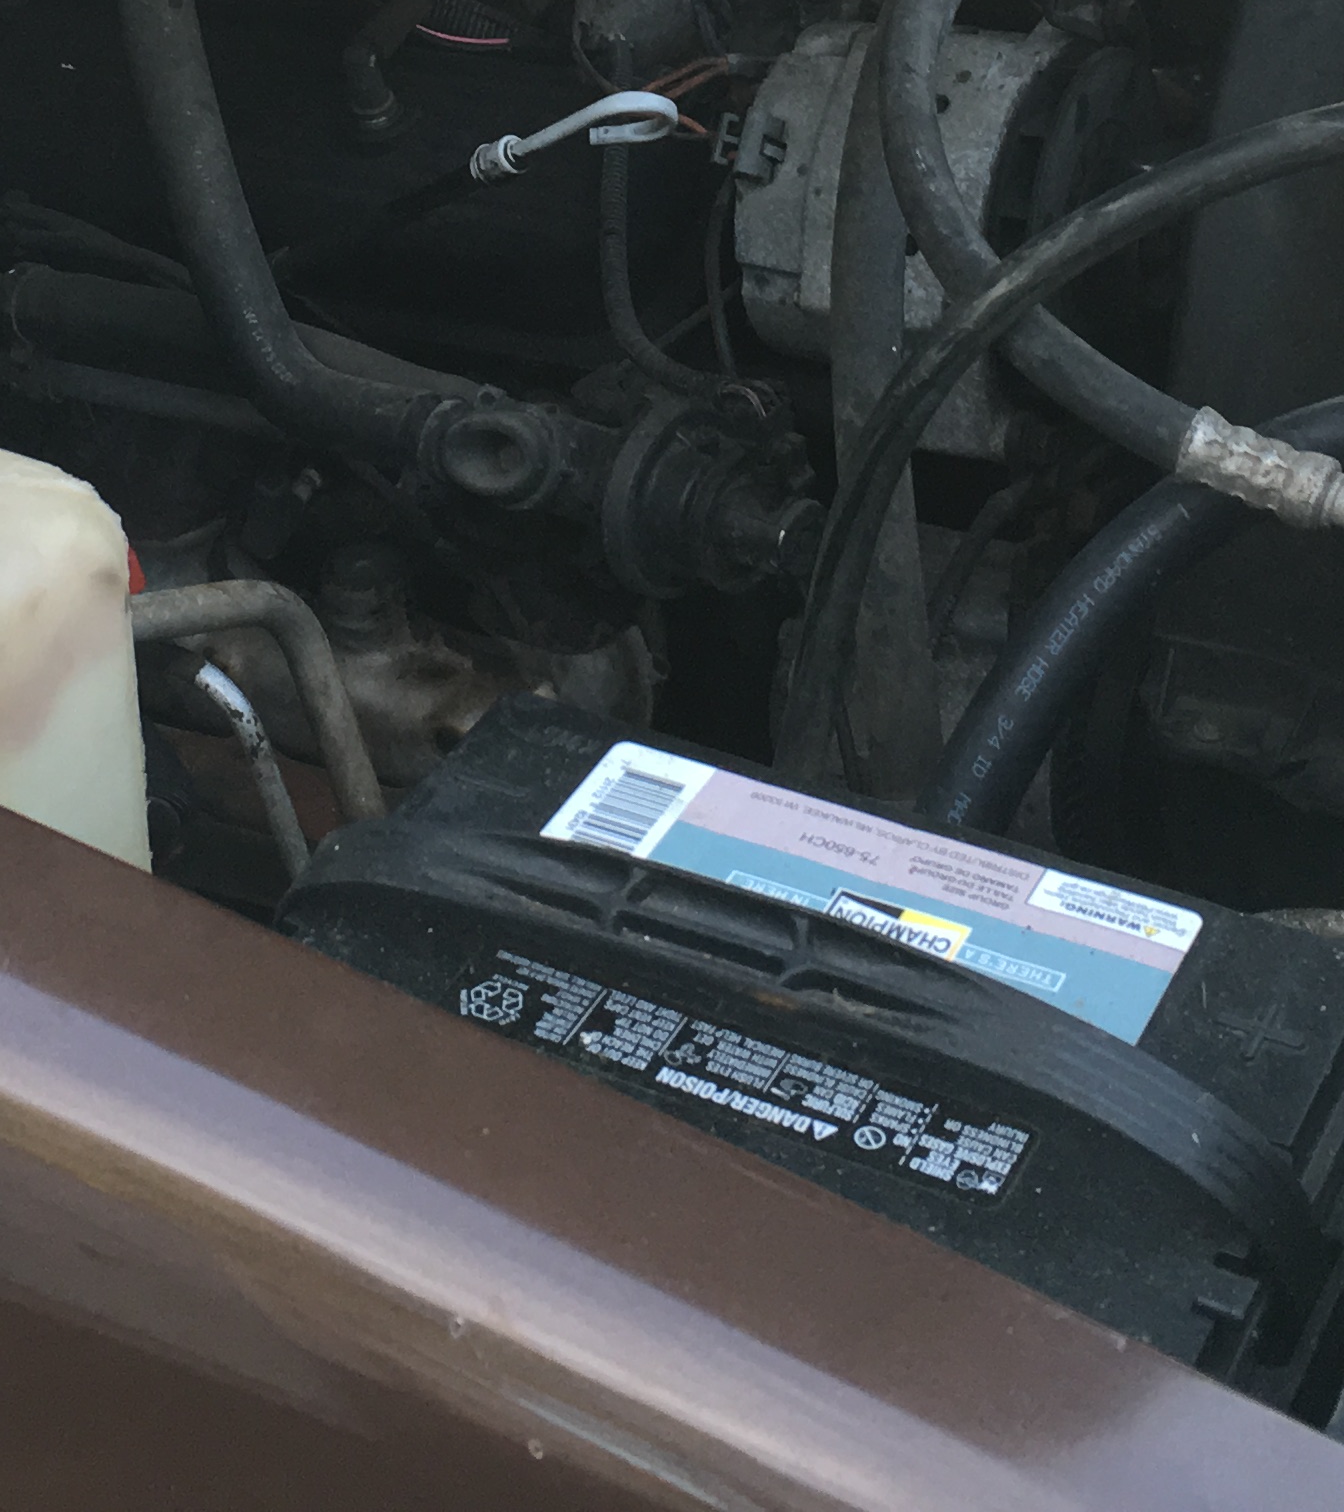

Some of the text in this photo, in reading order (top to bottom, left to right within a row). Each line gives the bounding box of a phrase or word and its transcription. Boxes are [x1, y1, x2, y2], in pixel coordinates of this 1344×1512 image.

[1093, 524, 1163, 594] STANDARD
[1045, 592, 1096, 656] HEATER
[1014, 655, 1050, 702] HOSE
[987, 714, 1015, 750] 3/4
[971, 754, 993, 779] ID
[795, 831, 883, 865] 75-650CH
[928, 843, 950, 856] BY
[946, 849, 1032, 881] DISTRIBUTED
[739, 877, 790, 901] HERE
[831, 904, 955, 953] CHAMPION
[974, 951, 1055, 986] THERE'S
[600, 1046, 623, 1061] OUT
[619, 1053, 648, 1070] KEEP
[653, 1064, 812, 1132] DANGER/POISON
[873, 1100, 917, 1123] FLAMES
[891, 1132, 912, 1148] NO
[917, 1133, 1012, 1175] EXPLOSIVE GASES
[907, 1155, 956, 1181] SHIELD
[924, 1149, 962, 1170] EYES
